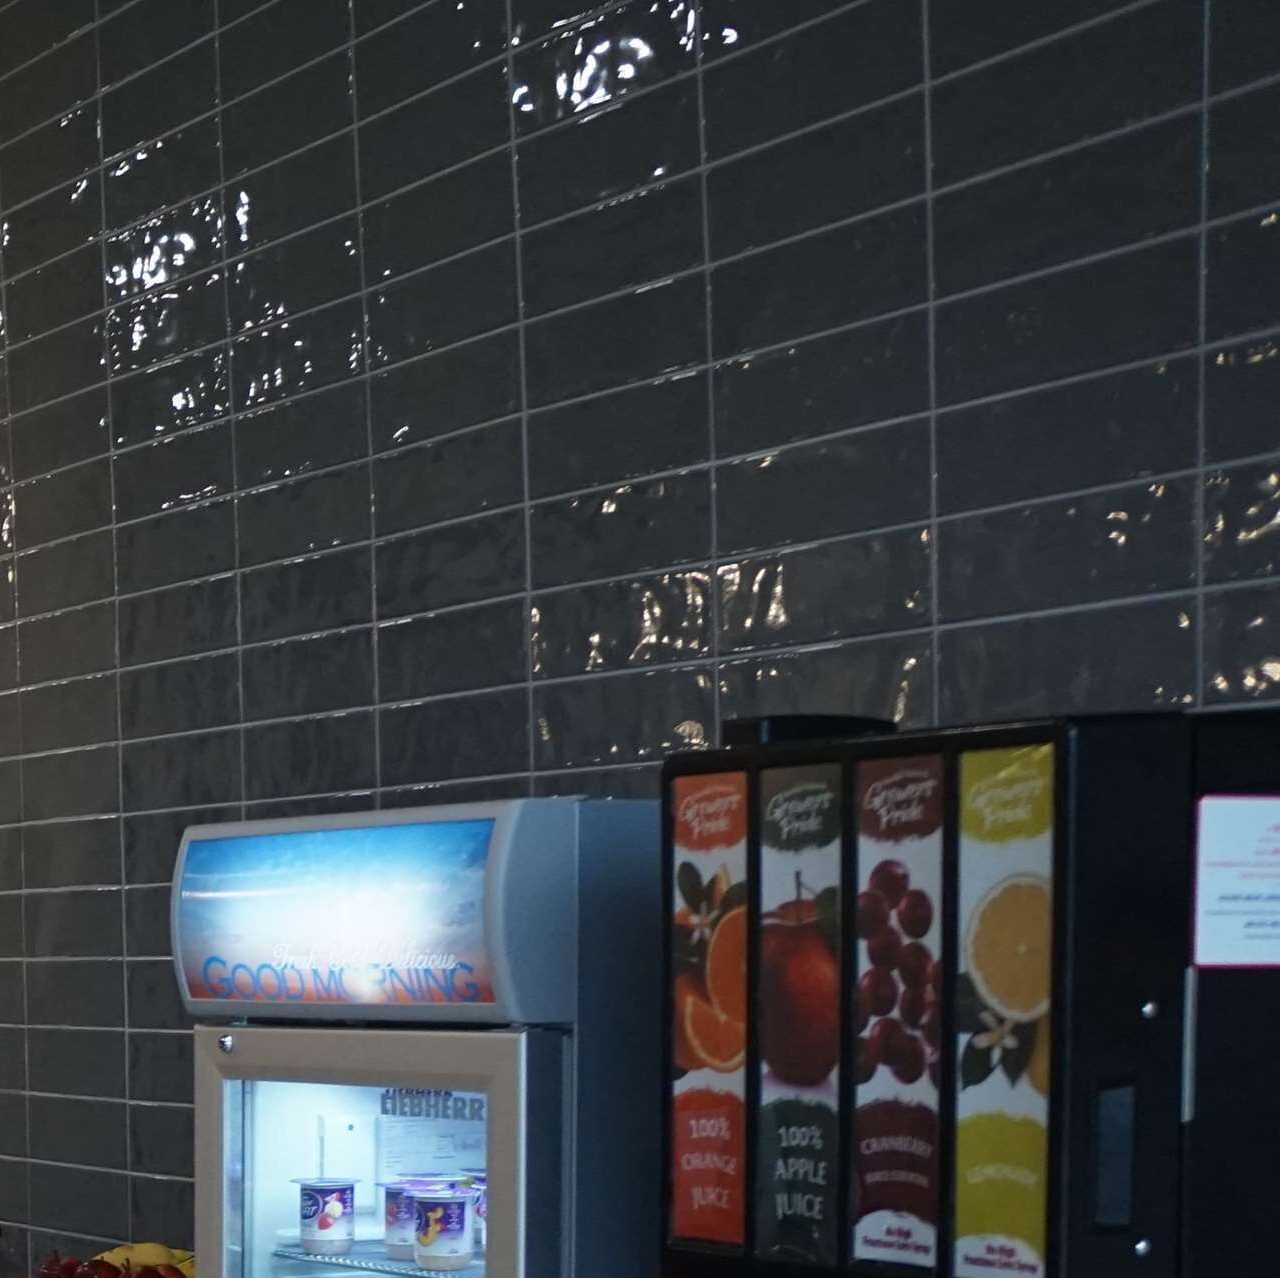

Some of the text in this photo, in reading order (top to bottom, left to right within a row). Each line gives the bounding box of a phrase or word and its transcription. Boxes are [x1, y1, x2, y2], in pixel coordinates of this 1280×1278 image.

[202, 955, 305, 1001] GOOD
[688, 1117, 731, 1140] 100%
[777, 1125, 824, 1150] 100%
[680, 1152, 738, 1176] ORANGE
[774, 1158, 827, 1186] APPLE
[691, 1185, 730, 1210] JUICE
[774, 1193, 824, 1221] JUICE
